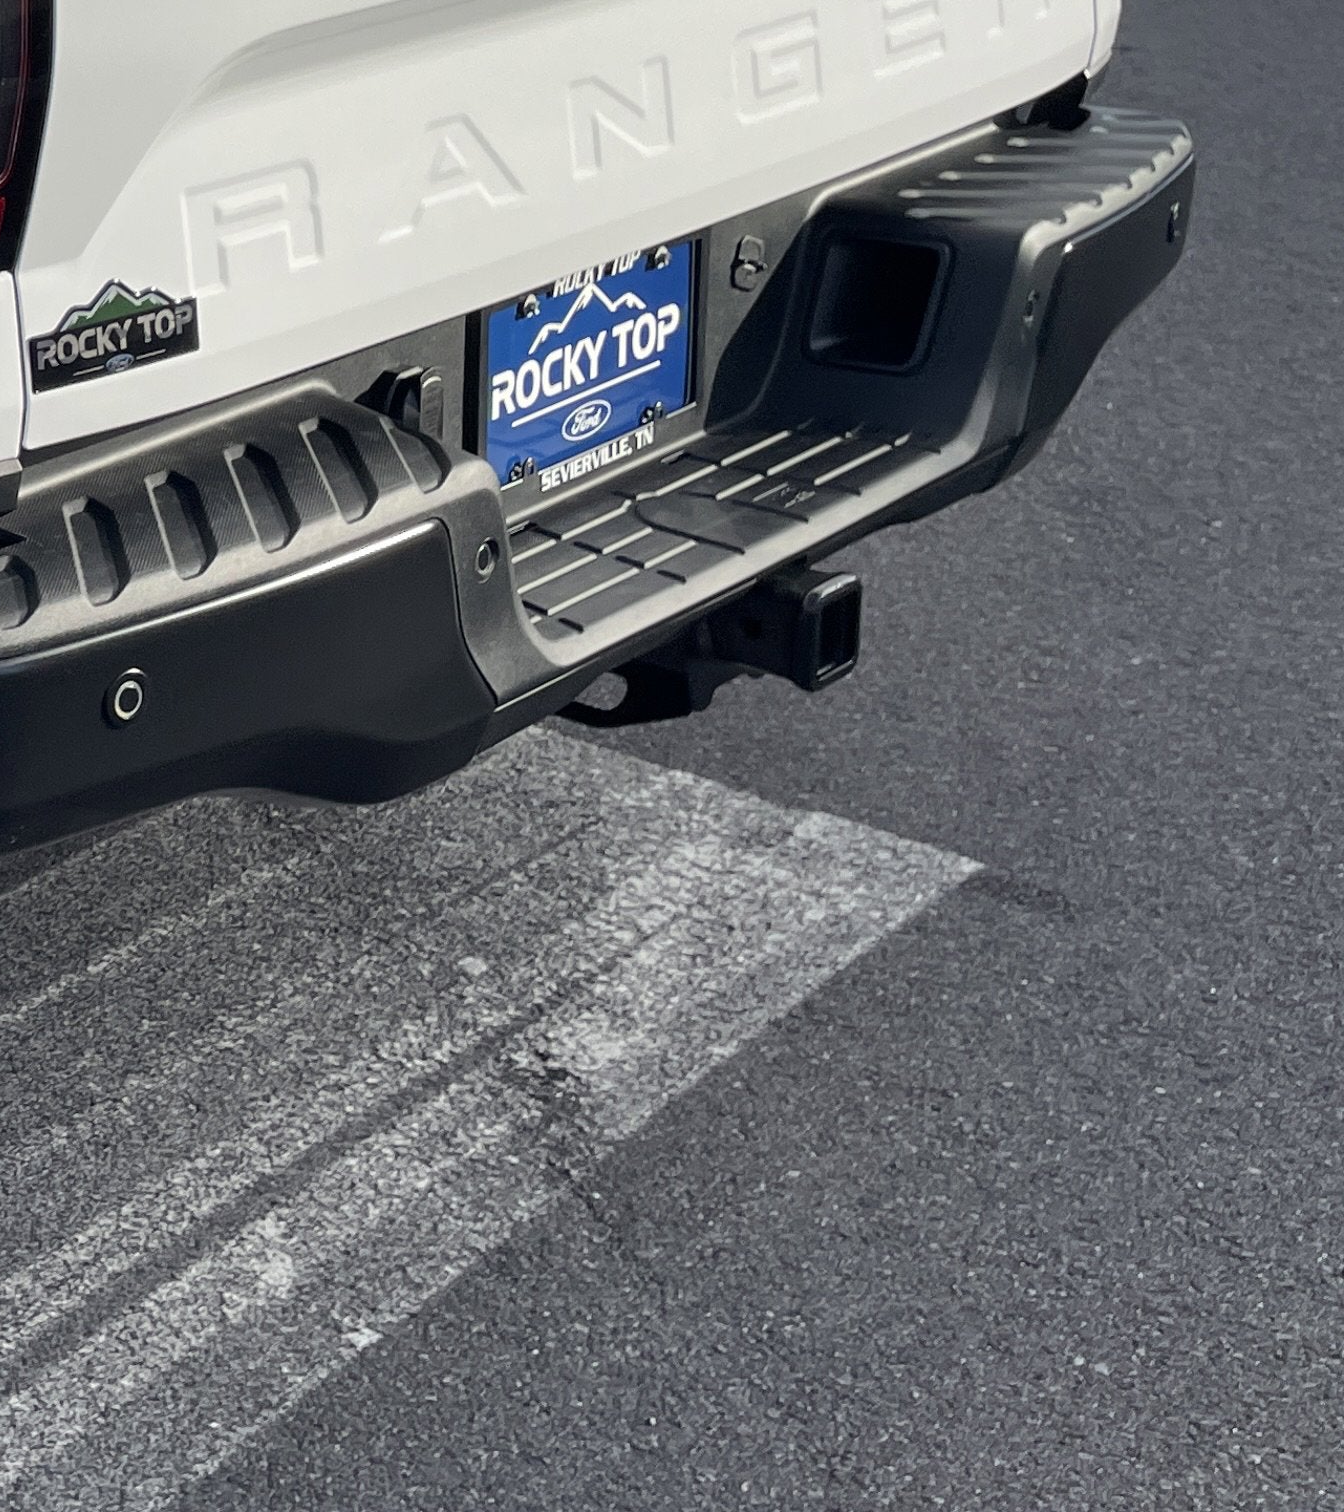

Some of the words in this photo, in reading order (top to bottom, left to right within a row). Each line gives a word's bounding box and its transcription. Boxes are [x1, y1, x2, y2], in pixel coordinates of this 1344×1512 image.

[36, 318, 134, 371] ROCKY
[137, 304, 193, 344] TOP
[491, 331, 608, 421] ROCKY
[612, 302, 680, 368] TOP
[570, 405, 603, 436] Ford
[541, 437, 633, 492] SEVIERVILLE,
[634, 423, 654, 450] TN
